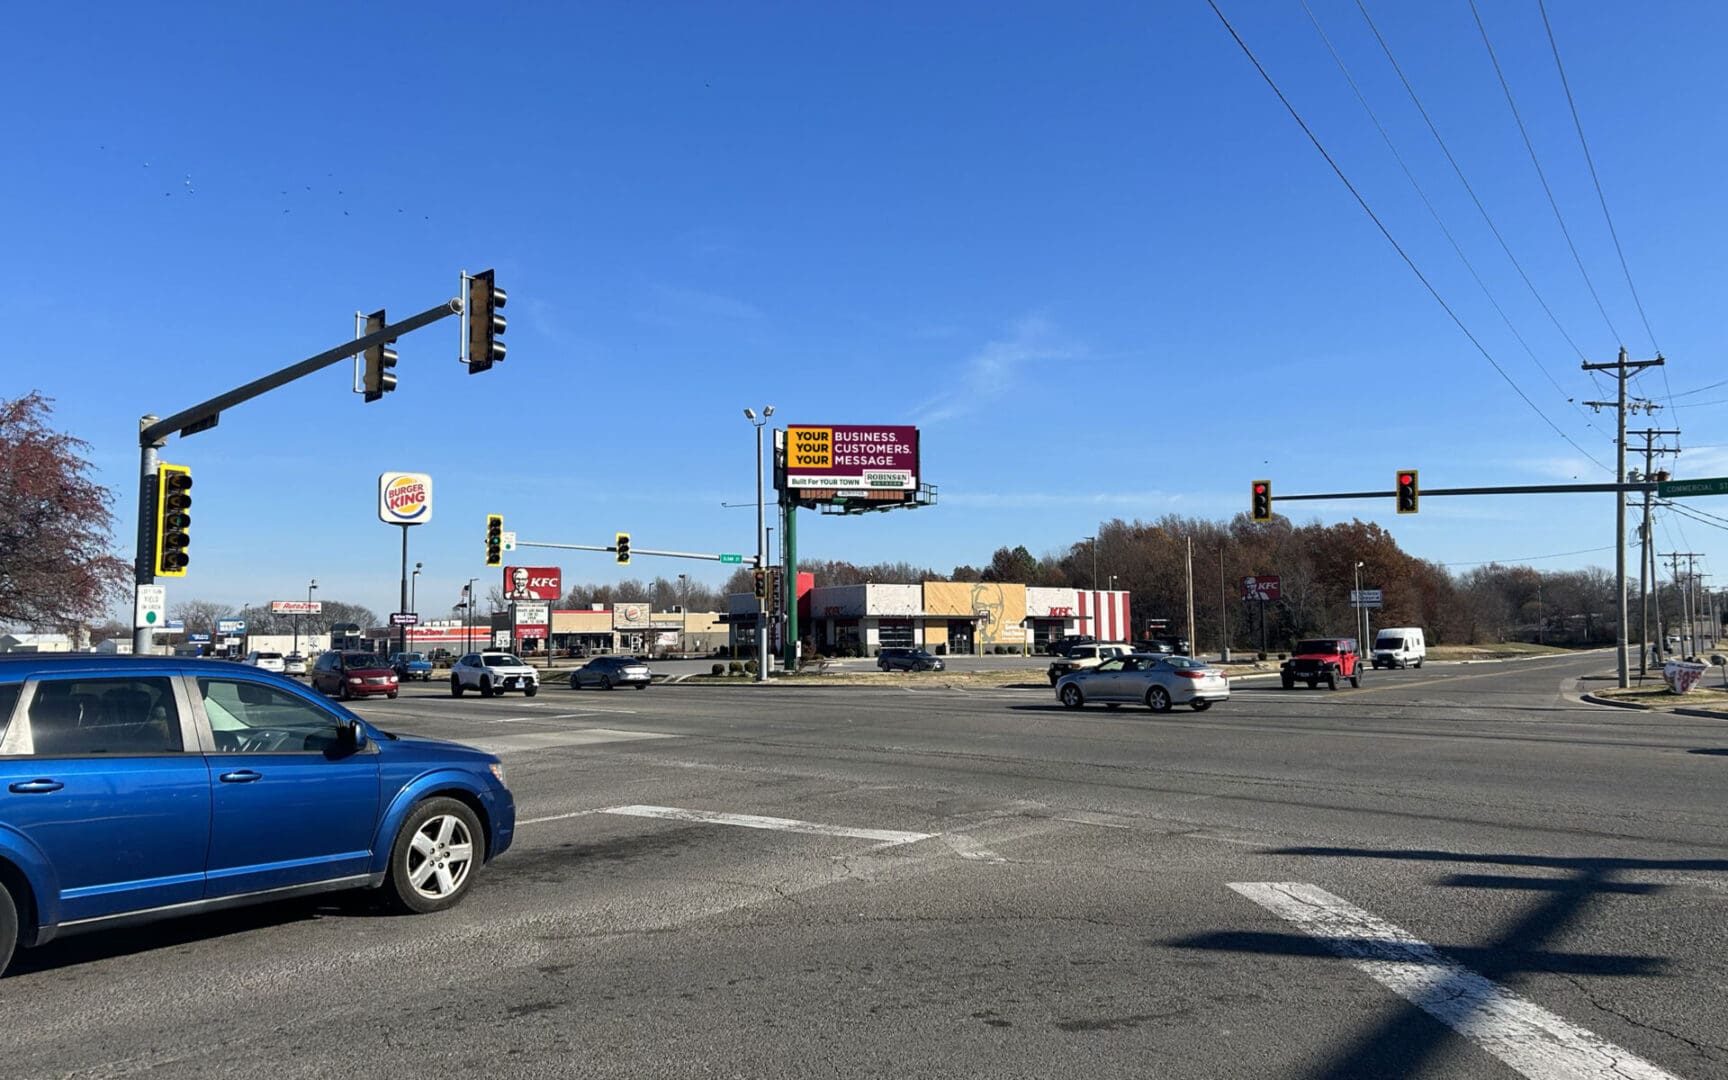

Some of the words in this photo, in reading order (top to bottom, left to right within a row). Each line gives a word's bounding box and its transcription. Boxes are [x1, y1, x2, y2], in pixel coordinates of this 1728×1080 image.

[796, 432, 829, 441] YOUR
[834, 432, 898, 442] BUSINESS.
[796, 443, 829, 453] YOUR
[834, 443, 912, 454] CUSTOMERS.
[796, 455, 829, 465] YOUR
[834, 455, 897, 466] MESSAGE.
[388, 483, 425, 499] BURGER
[1666, 484, 1713, 493] COMMERCIAL
[390, 491, 426, 510] KING
[530, 577, 558, 588] KFC
[1258, 582, 1278, 590] KFC
[282, 602, 320, 610] AutoZone
[1050, 607, 1073, 617] KFC
